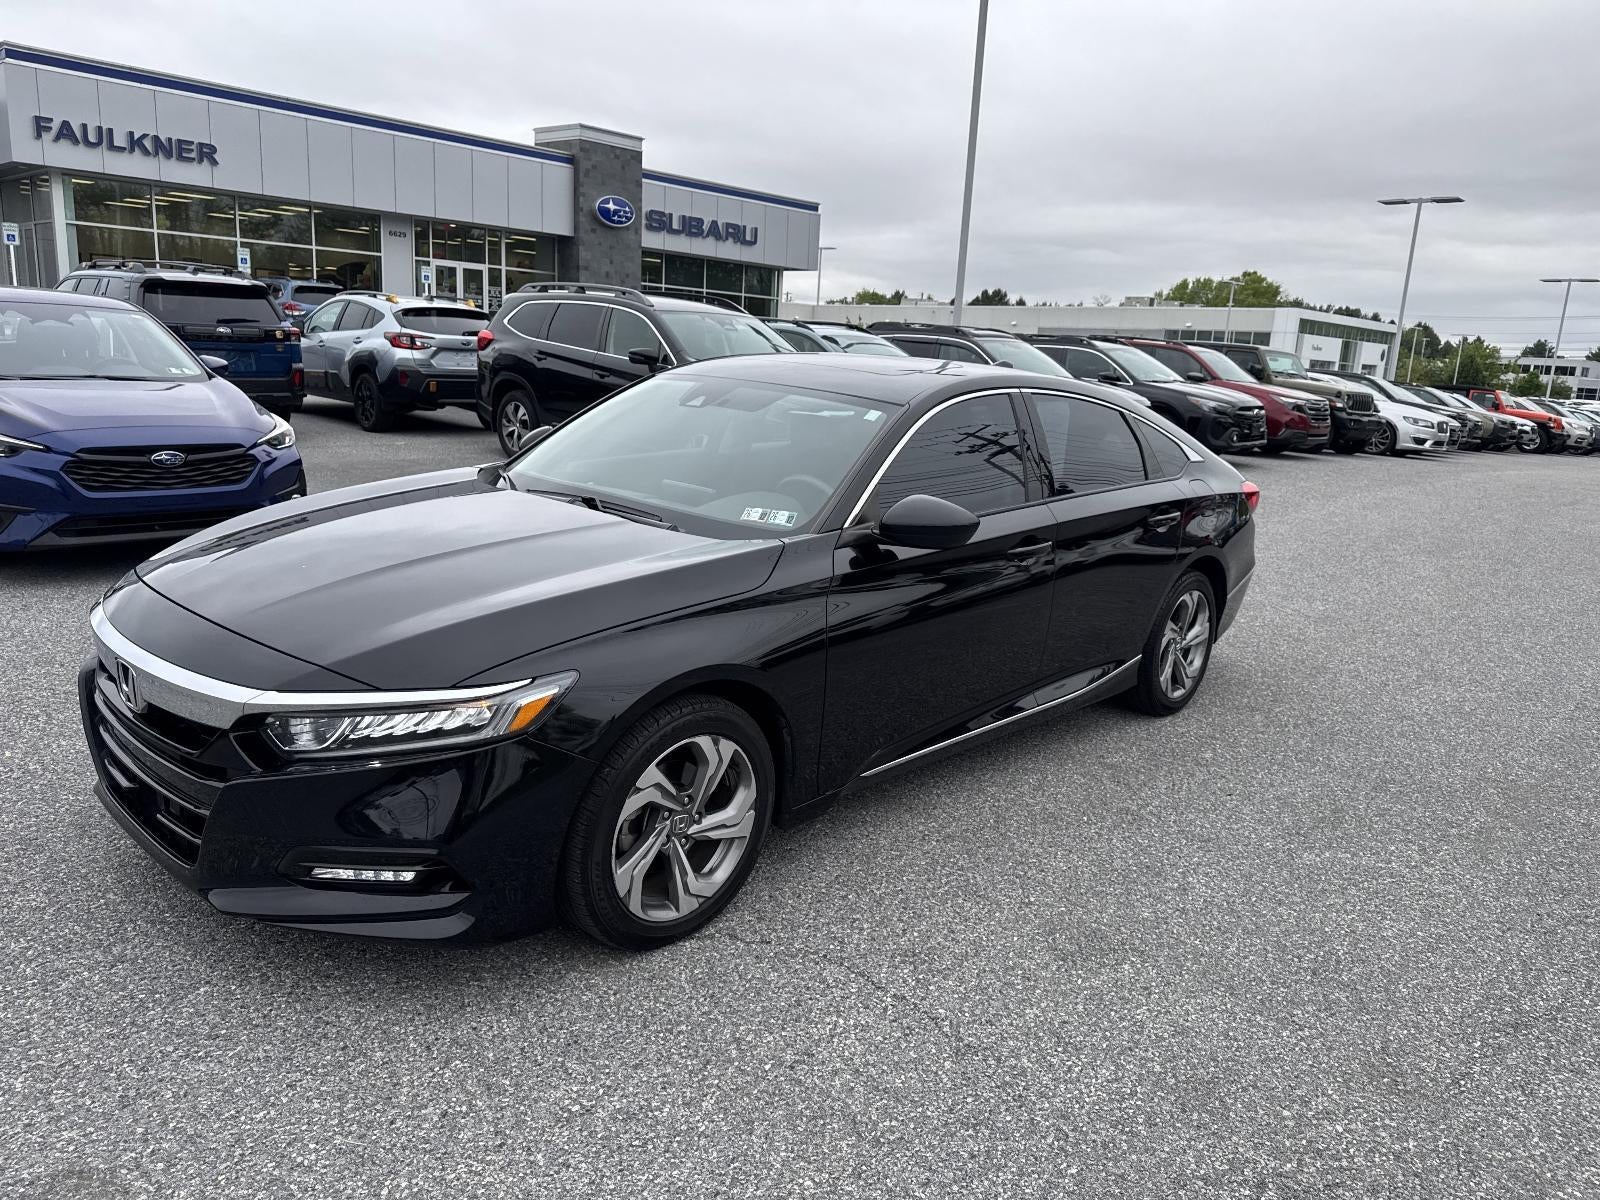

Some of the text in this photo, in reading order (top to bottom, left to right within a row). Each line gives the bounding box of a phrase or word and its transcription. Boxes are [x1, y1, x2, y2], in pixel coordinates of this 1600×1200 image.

[32, 115, 219, 167] FAULKNER
[388, 230, 407, 239] 6629
[645, 209, 758, 246] SUBARU
